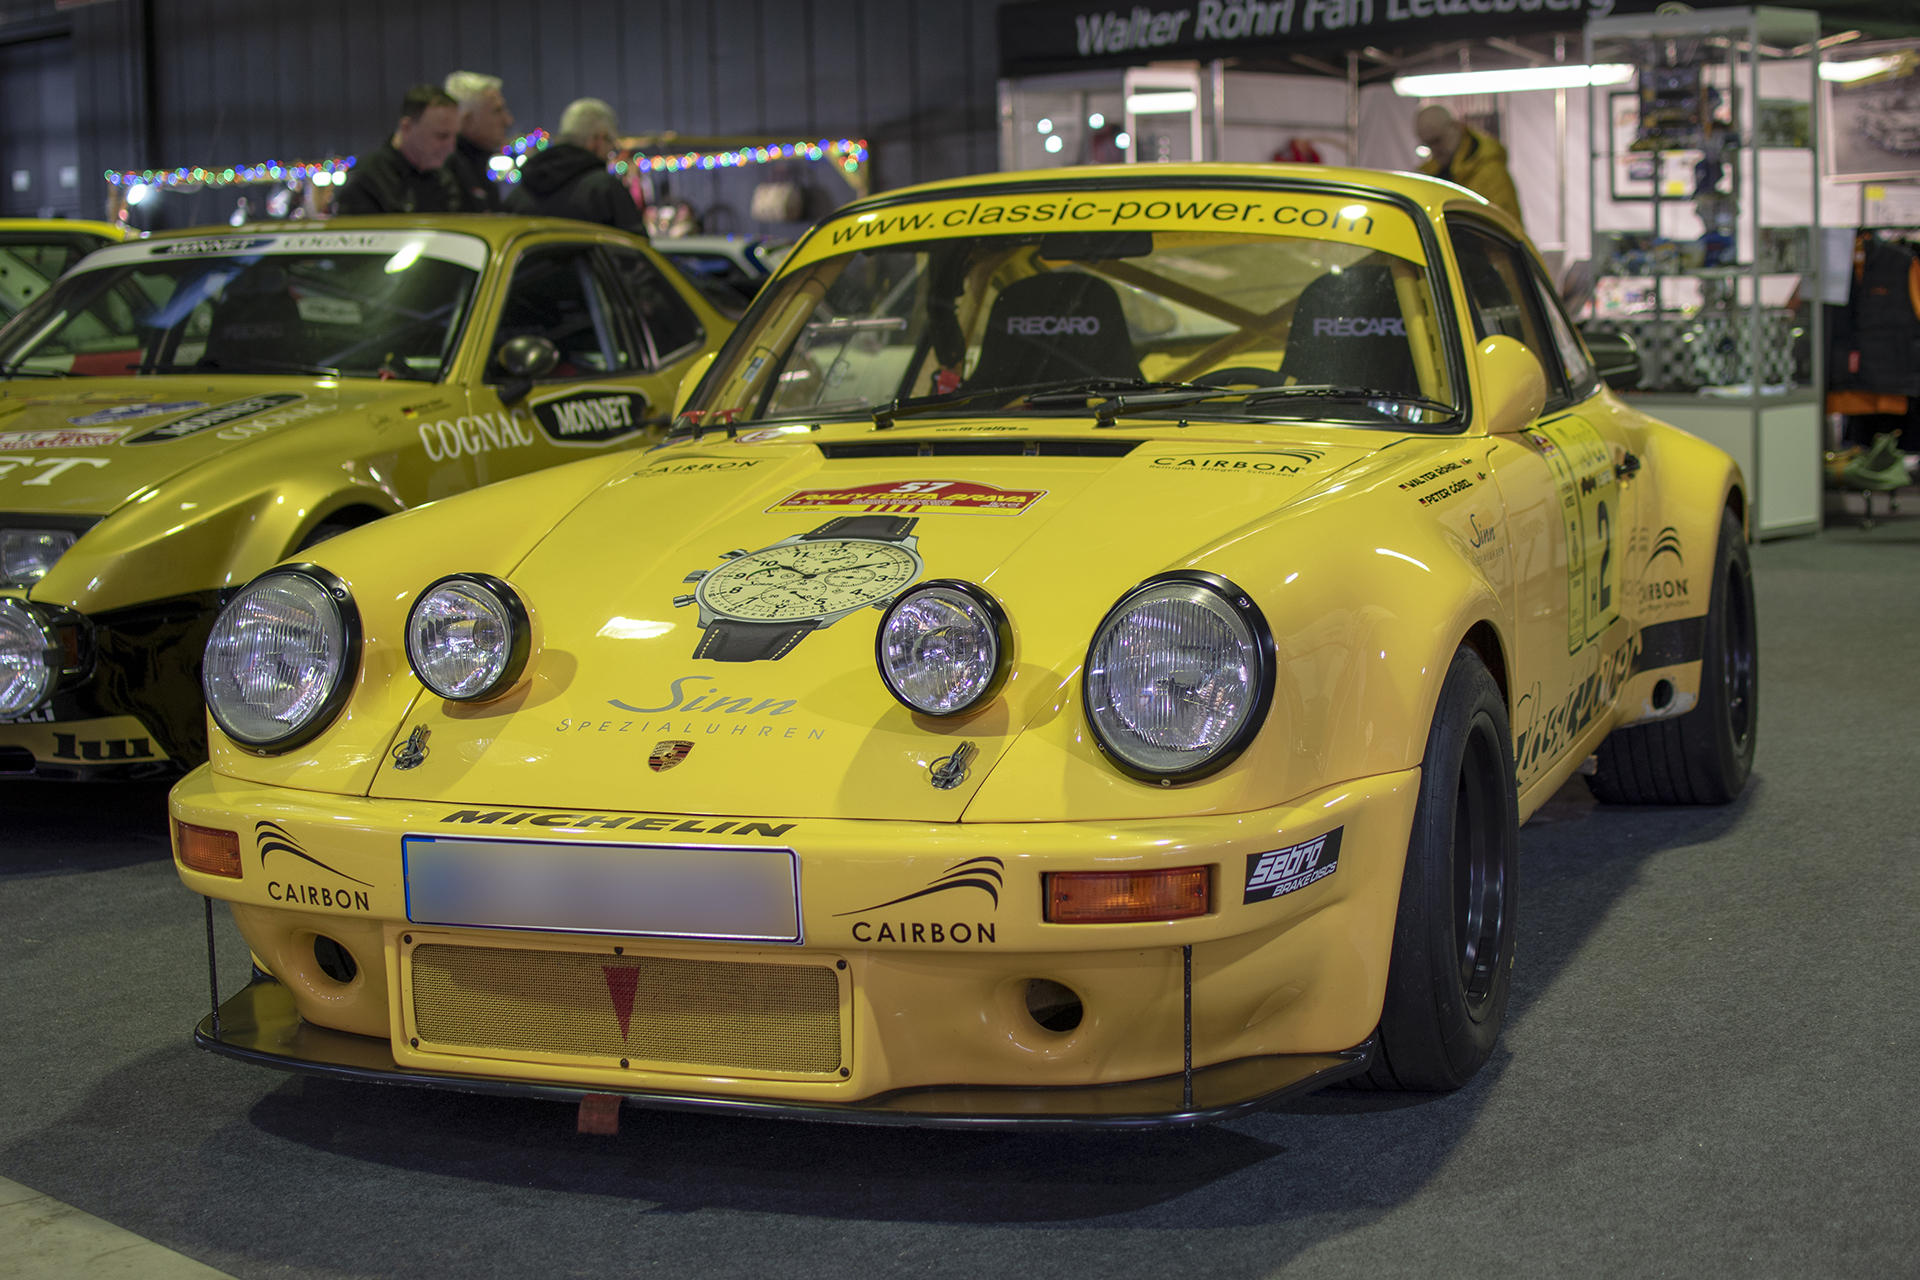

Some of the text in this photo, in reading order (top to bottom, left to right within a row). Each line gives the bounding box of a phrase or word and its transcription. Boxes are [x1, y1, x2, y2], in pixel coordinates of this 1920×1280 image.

[1076, 6, 1190, 55] Walter
[832, 197, 1375, 246] www.classic-power.com
[1007, 317, 1099, 336] RECARO
[552, 395, 632, 435] MONNET
[419, 408, 533, 462] COGNAC
[633, 460, 759, 475] CAIRBON
[1154, 457, 1300, 474] CAIRBON
[1405, 471, 1439, 488] WALTER
[941, 493, 1027, 502] BRAVA
[1424, 488, 1452, 505] PETER
[1469, 513, 1496, 549] Sinn
[607, 675, 798, 716] Sinn
[556, 718, 825, 740] SPEZIALUHREN
[440, 809, 799, 838] MICHELIN
[1272, 861, 1338, 897] BRAKE DISCS
[268, 881, 370, 911] CAIRBON
[852, 921, 996, 944] CAIRBON
